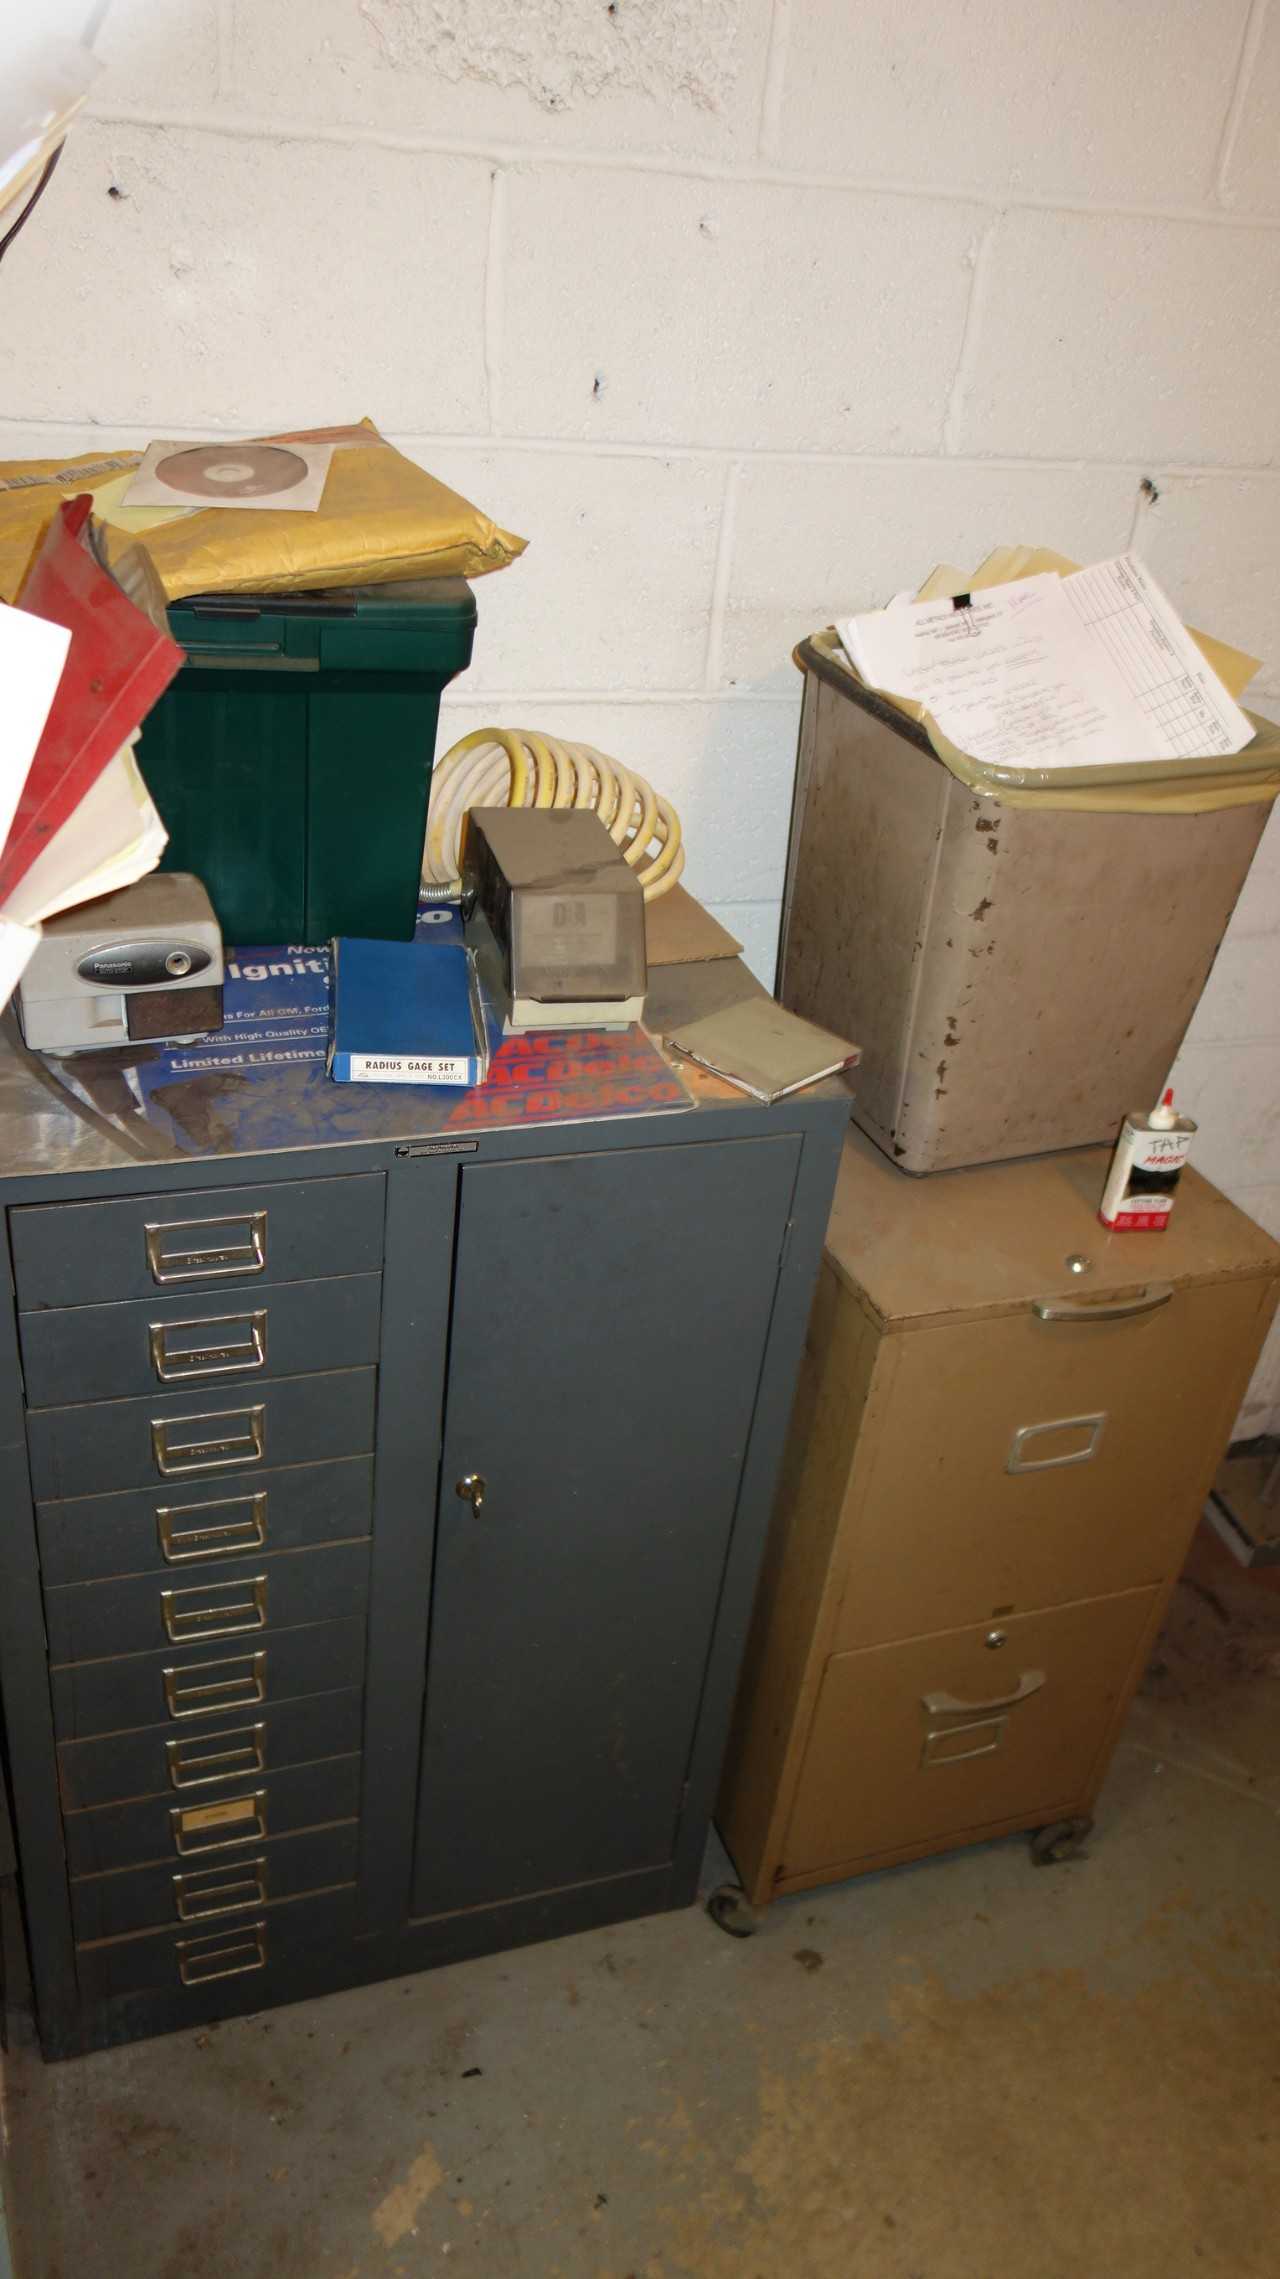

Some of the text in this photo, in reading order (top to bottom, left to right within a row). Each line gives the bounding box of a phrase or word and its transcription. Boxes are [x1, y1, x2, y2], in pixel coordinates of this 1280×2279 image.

[236, 1010, 255, 1020] For
[258, 1008, 274, 1018] All
[203, 1035, 232, 1045] With
[234, 1031, 262, 1043] High
[264, 1026, 308, 1039] Quality
[170, 1048, 326, 1070] Limited Lifetime
[365, 1060, 456, 1073] RADIUS GAGE SET
[1148, 1135, 1190, 1154] TAP
